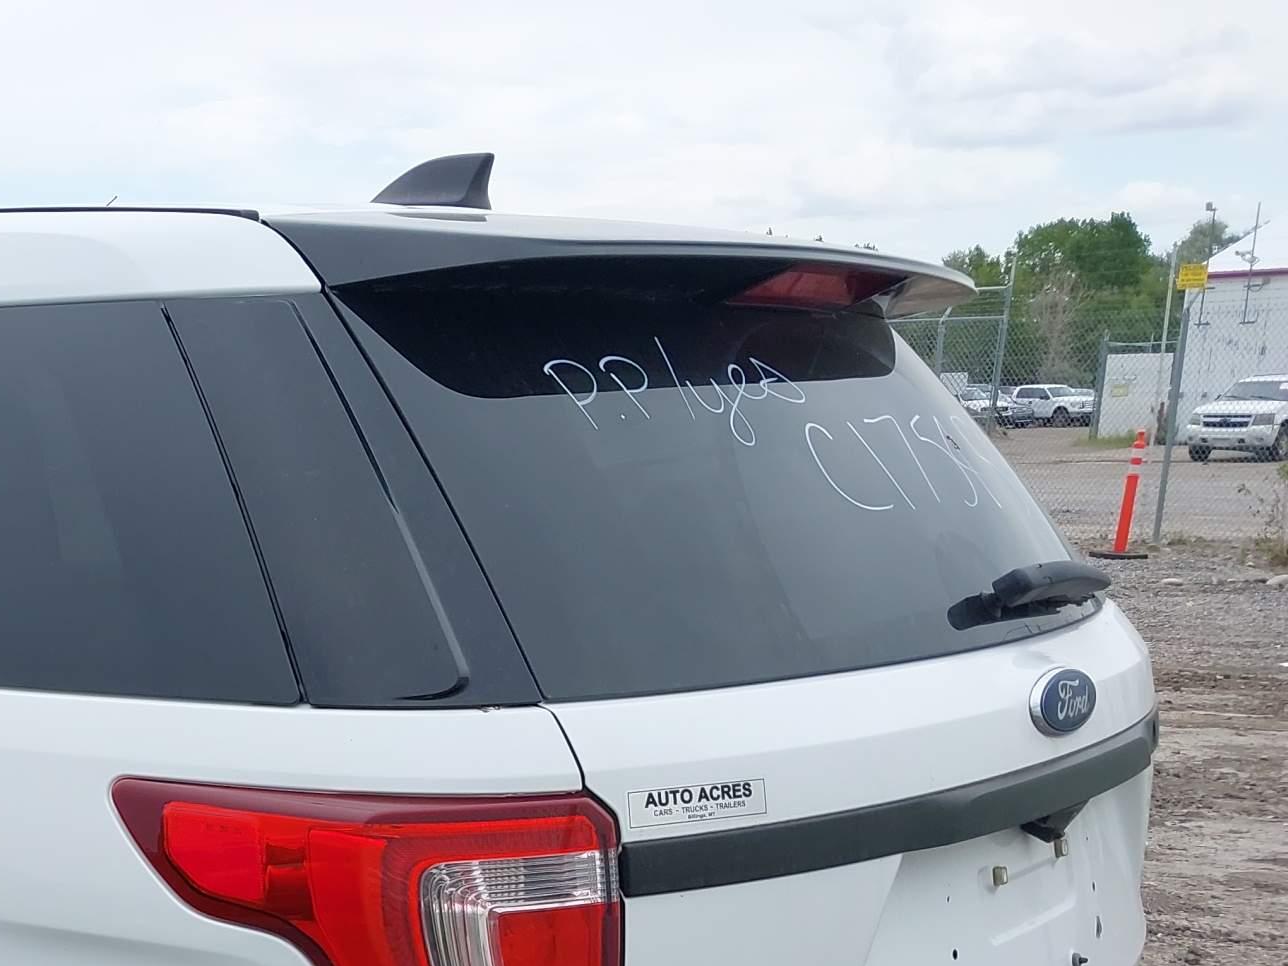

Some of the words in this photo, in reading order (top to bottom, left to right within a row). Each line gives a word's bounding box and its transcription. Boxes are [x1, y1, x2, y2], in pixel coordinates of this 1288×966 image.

[1057, 678, 1090, 721] Ford
[644, 788, 693, 808] AUTO
[697, 782, 753, 803] ACRES
[653, 808, 673, 817] CARS
[681, 804, 709, 815] TRUCKS
[715, 800, 746, 810] TRAILERS
